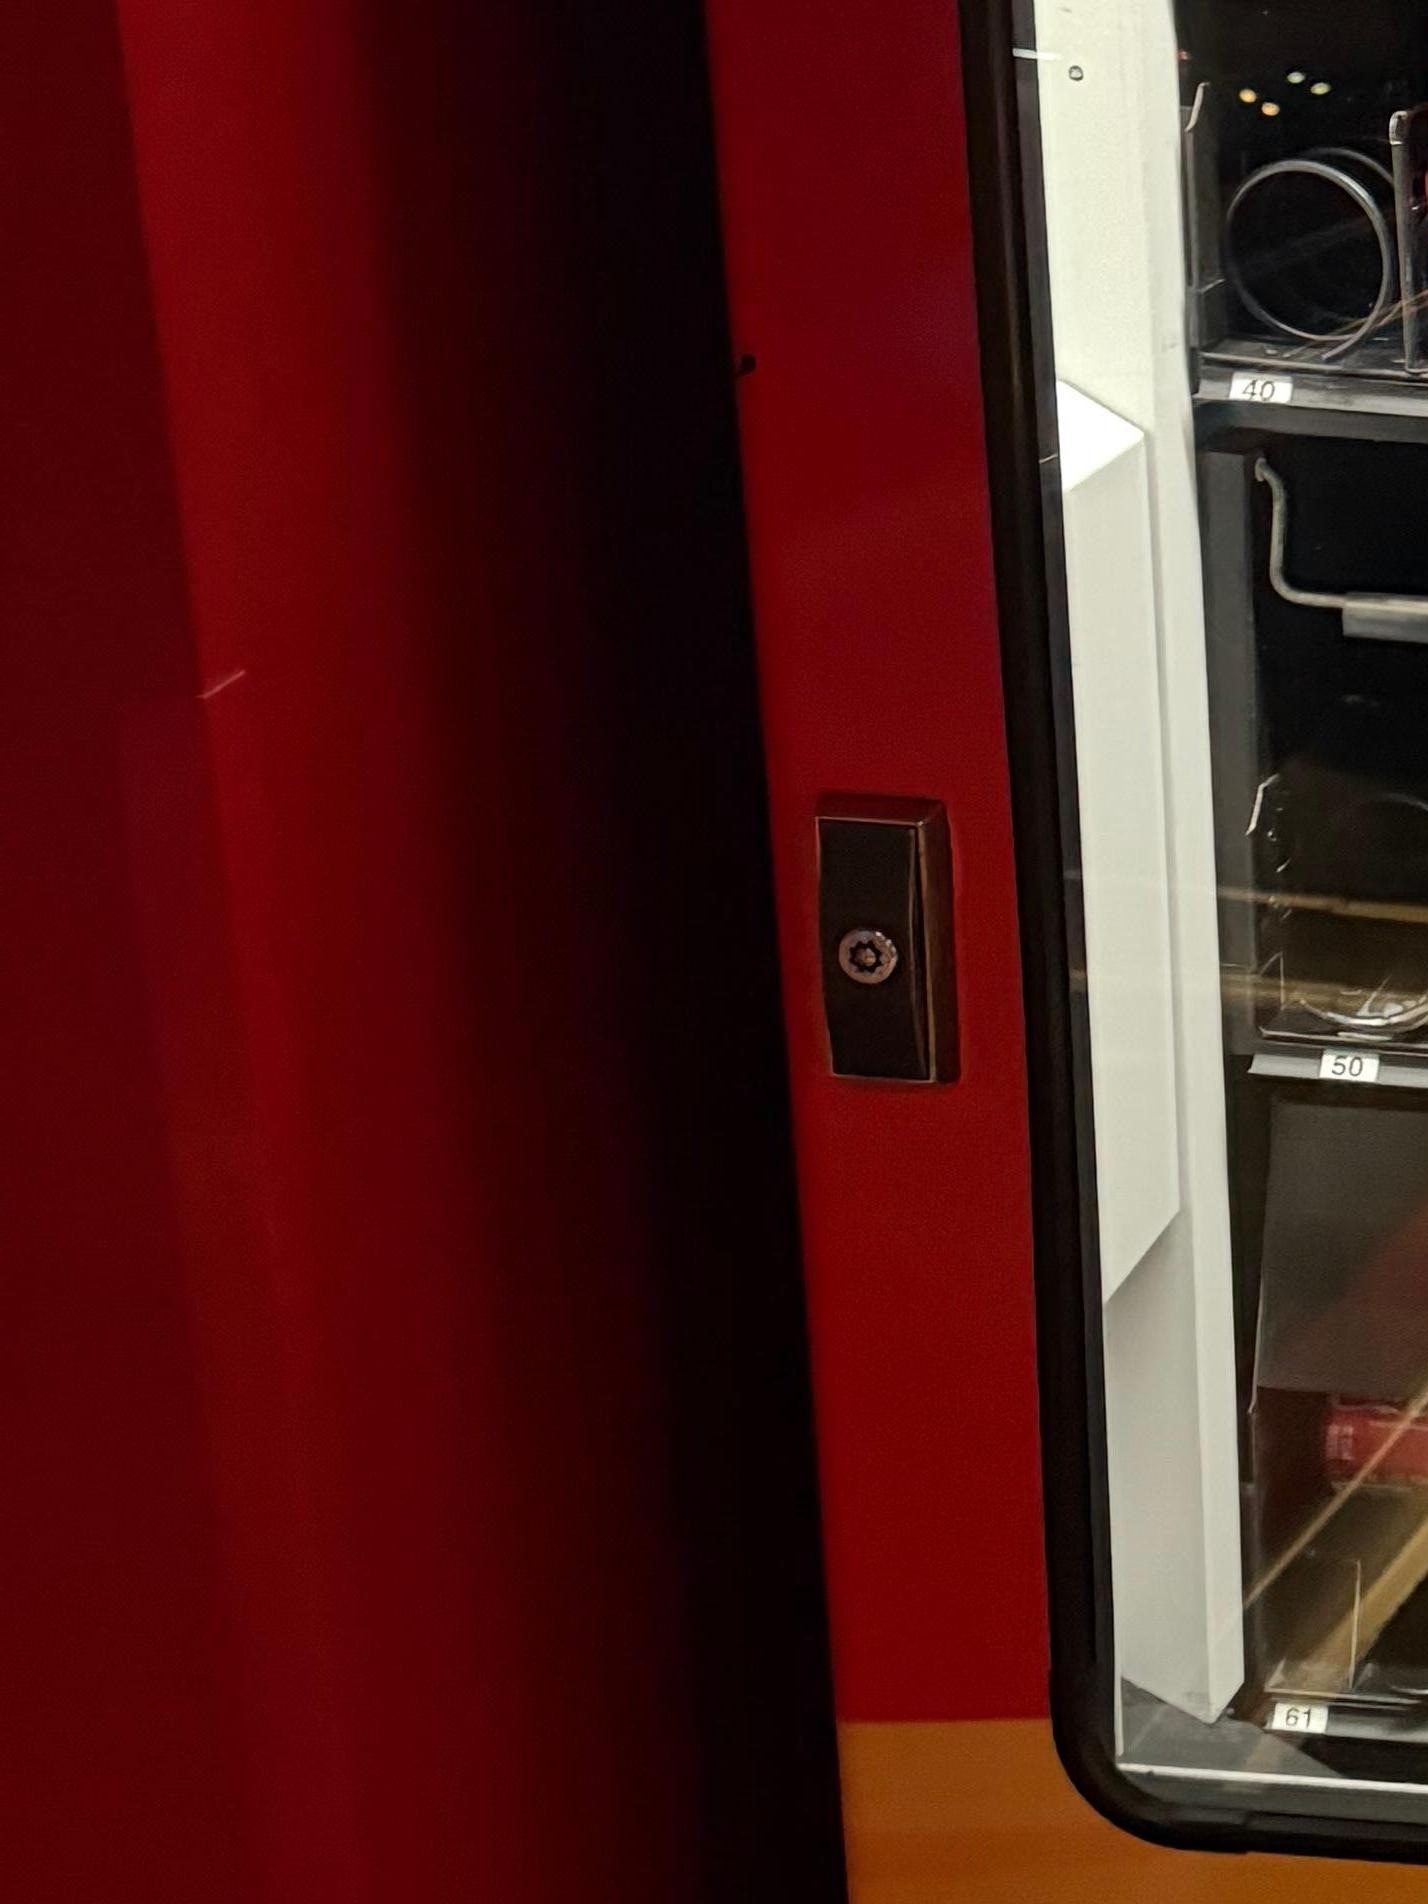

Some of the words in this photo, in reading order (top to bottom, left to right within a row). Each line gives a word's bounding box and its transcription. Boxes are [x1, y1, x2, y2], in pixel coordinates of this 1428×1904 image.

[1241, 379, 1275, 401] 40
[1331, 1055, 1364, 1077] 50
[1285, 1707, 1312, 1728] 61
